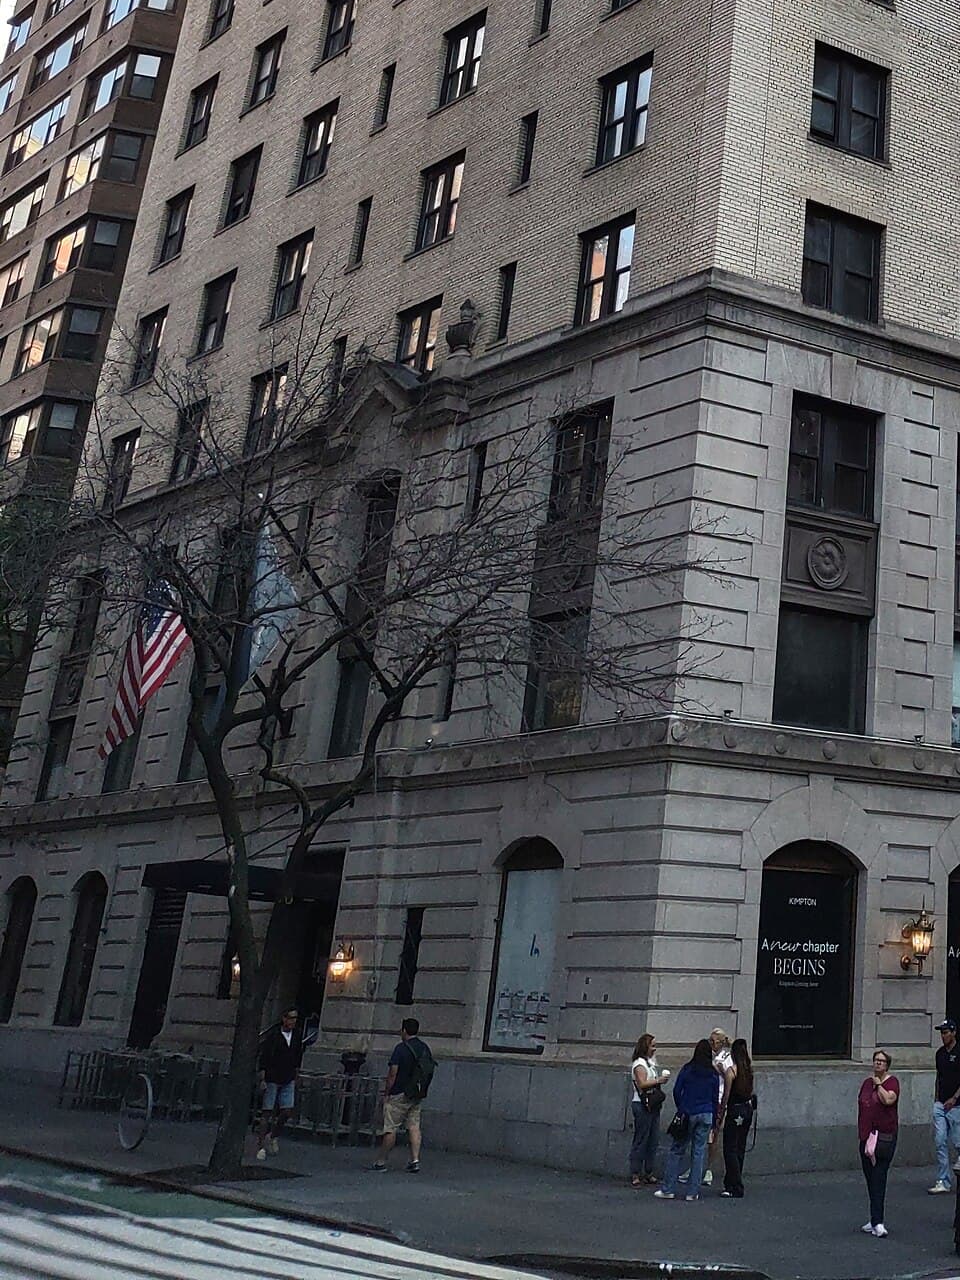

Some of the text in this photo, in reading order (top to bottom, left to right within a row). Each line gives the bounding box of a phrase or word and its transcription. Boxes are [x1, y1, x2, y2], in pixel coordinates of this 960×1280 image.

[788, 897, 817, 907] KIMPTON
[761, 938, 840, 956] A new chapter
[774, 957, 826, 976] BEGINS
